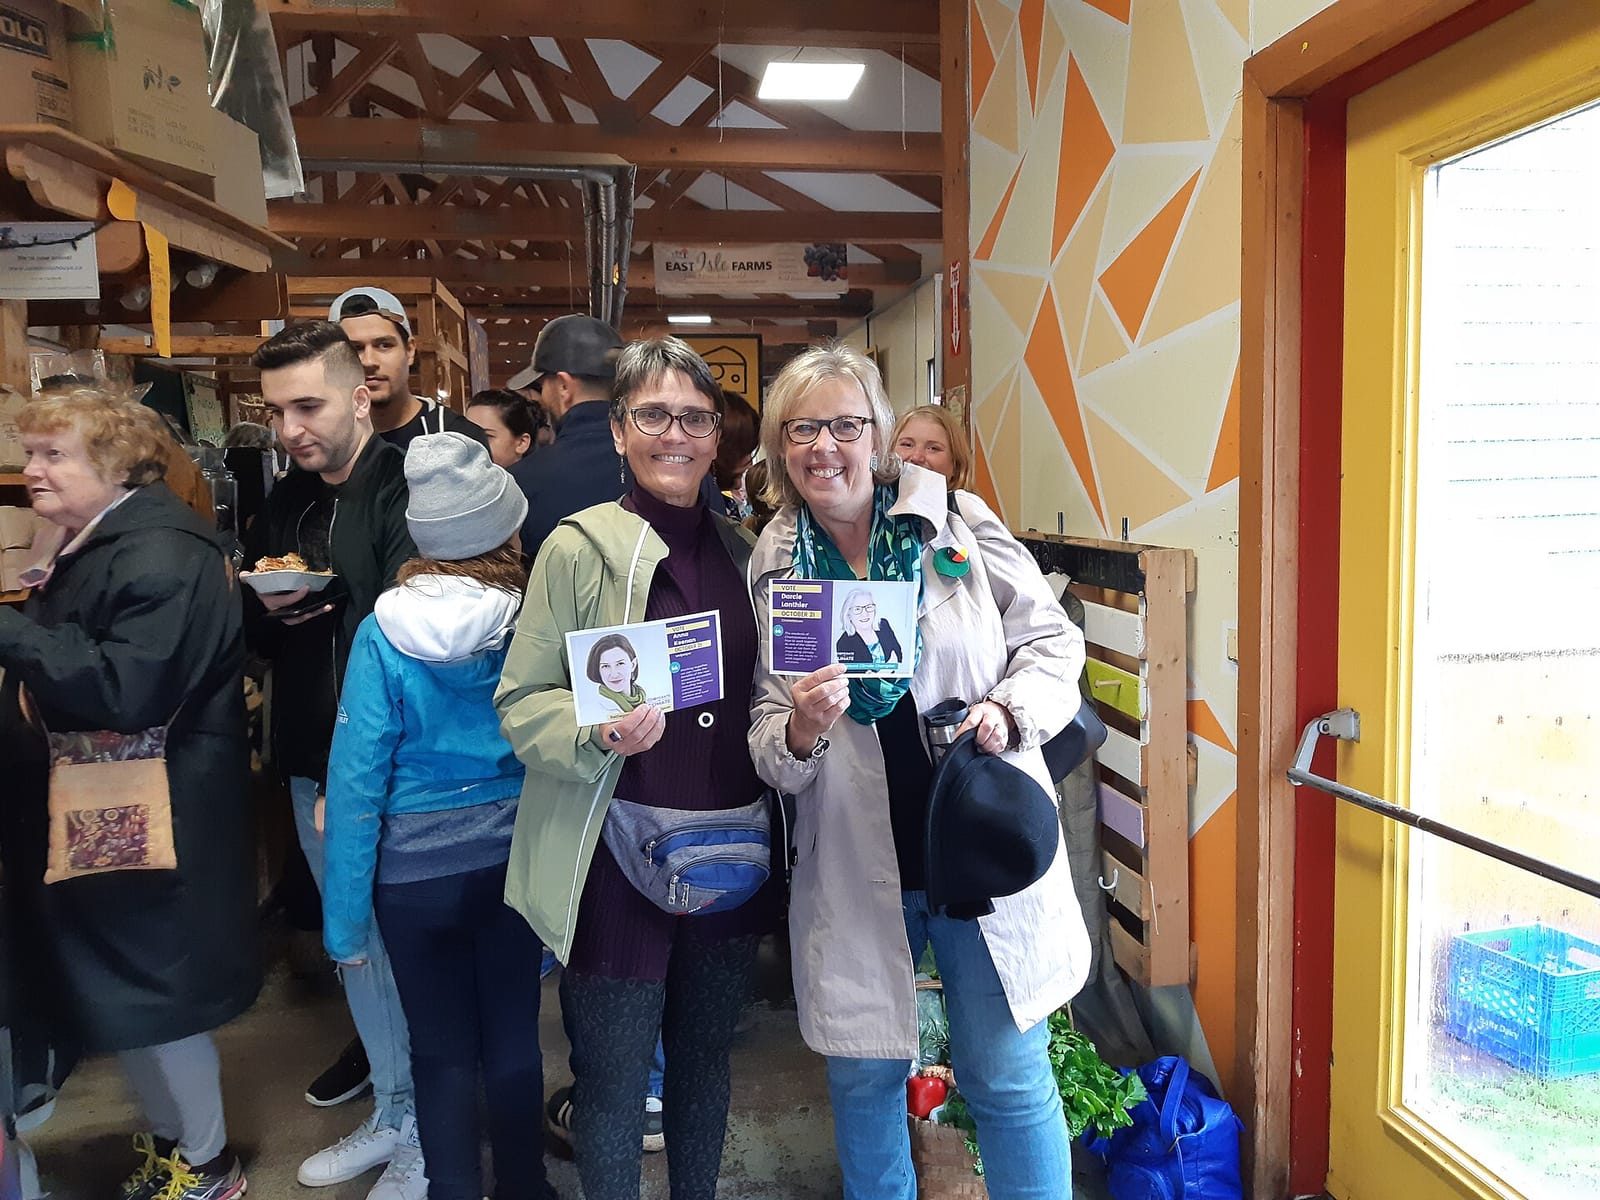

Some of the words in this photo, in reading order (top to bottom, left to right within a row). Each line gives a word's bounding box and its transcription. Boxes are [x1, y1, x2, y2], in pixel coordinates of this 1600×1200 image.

[665, 261, 694, 271] EAST
[697, 251, 727, 273] Isle
[732, 261, 772, 271] FARMS
